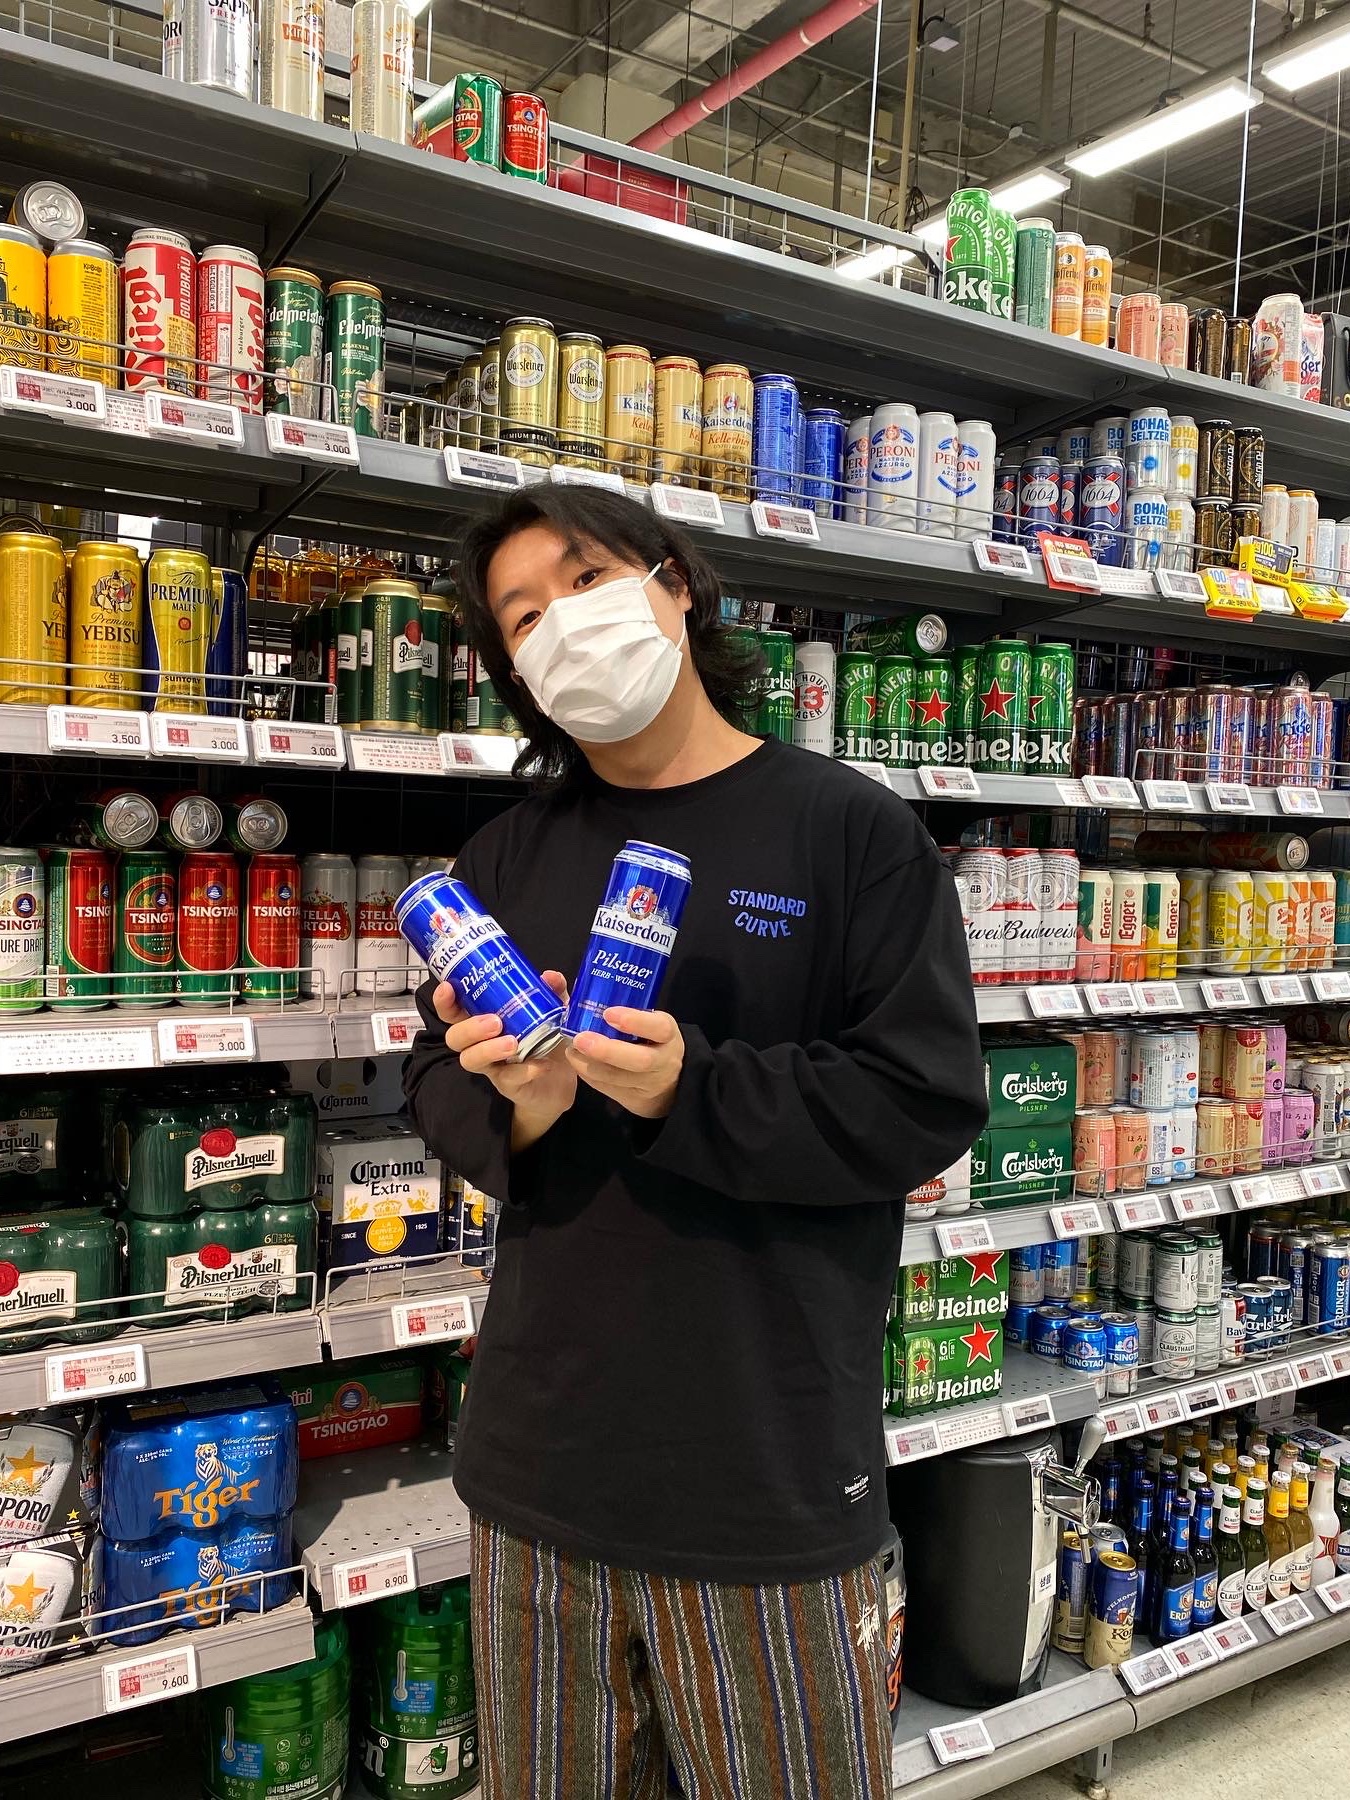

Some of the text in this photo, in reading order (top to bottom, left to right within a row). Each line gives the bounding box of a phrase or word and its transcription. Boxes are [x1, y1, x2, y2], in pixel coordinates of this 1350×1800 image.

[179, 256, 192, 319] GOLDBRÄU
[1131, 417, 1170, 432] BOHAE
[1131, 430, 1170, 443] SELTZER
[870, 445, 916, 459] PERONI
[1024, 486, 1055, 502] 1664
[1085, 486, 1115, 501] 1664
[151, 582, 211, 606] PREMIUM
[91, 613, 137, 630] Premium
[81, 624, 141, 646] YEBISU
[802, 674, 830, 697] HOUSE
[182, 905, 239, 918] TSINGTAO
[728, 889, 807, 917] STANDARD
[595, 910, 672, 948] Kaiserdom
[734, 911, 791, 938] CURVE
[1118, 900, 1136, 940] Egger
[431, 919, 499, 976] Kaiserdom
[592, 949, 653, 980] Pilsener
[591, 968, 646, 991] HERB WÜRZIG
[1001, 1072, 1068, 1104] Carlsberg
[319, 1094, 370, 1113] Corona
[1019, 1104, 1049, 1112] PILSNER
[191, 1154, 237, 1181] Pilsner
[350, 1159, 426, 1186] Corona
[1001, 1149, 1064, 1179] Carlsberg
[370, 1181, 411, 1197] Extra
[1018, 1181, 1046, 1190] PILSNER
[340, 1232, 357, 1240] SINCE
[415, 1222, 428, 1231] 1925
[180, 1265, 235, 1289] Pilsner
[1333, 1279, 1346, 1327] ERDINGER
[1065, 1352, 1104, 1368] TSINGTAO
[310, 1413, 390, 1440] TSINGTAO
[153, 1478, 261, 1528] Tiger
